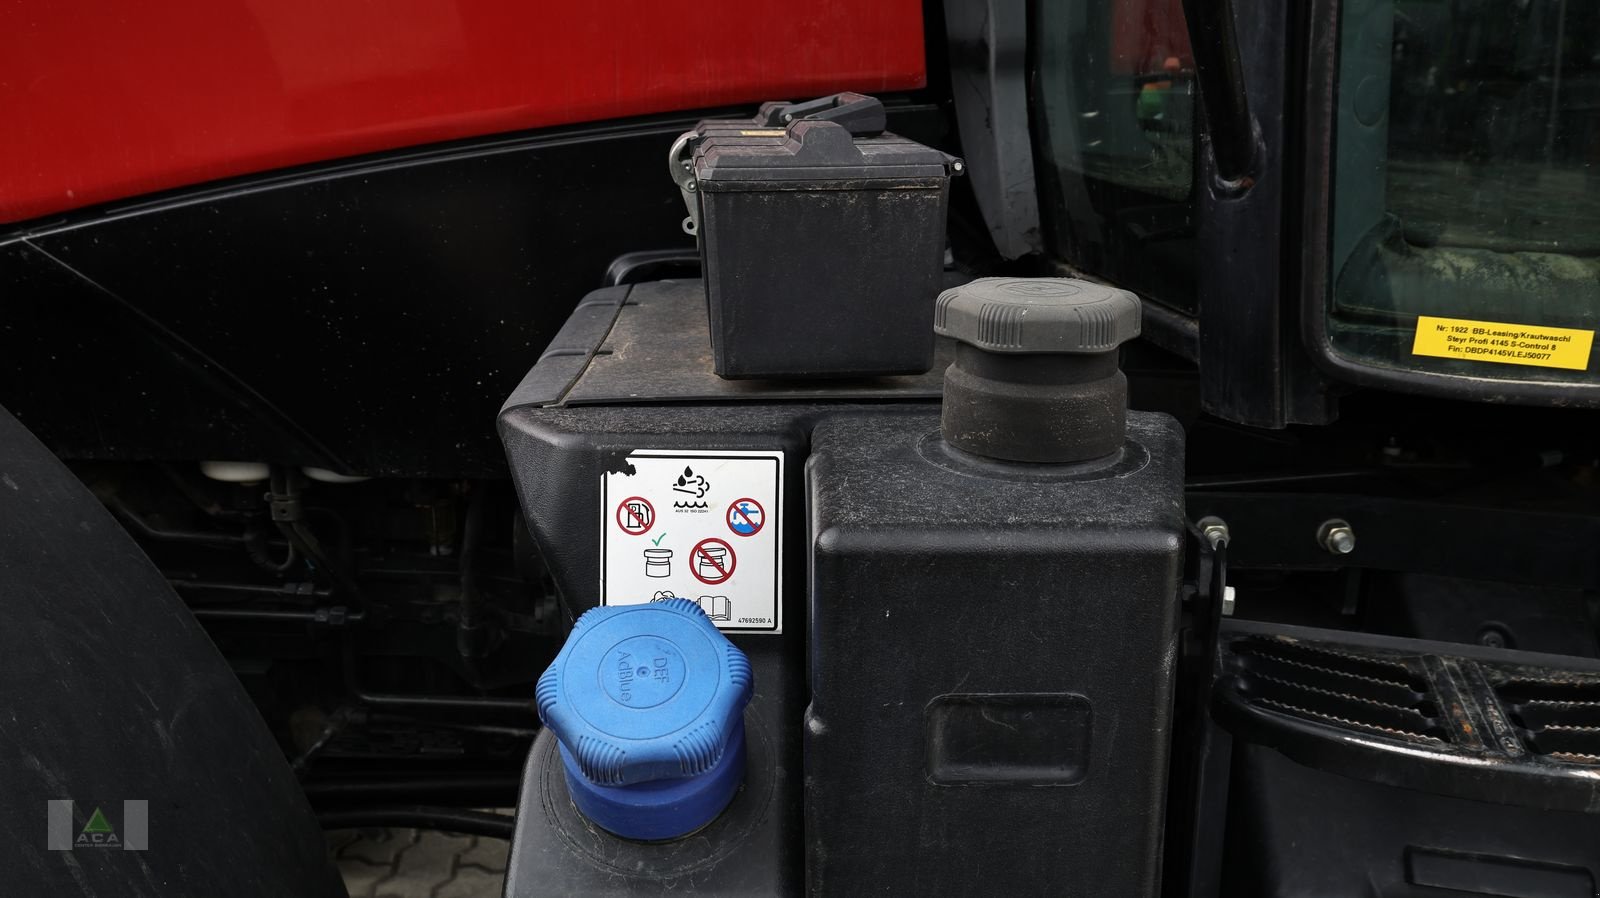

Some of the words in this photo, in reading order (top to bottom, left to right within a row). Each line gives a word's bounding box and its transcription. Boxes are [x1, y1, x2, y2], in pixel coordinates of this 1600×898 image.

[1436, 324, 1449, 332] Nr:
[1450, 325, 1468, 334] 1922
[1446, 335, 1467, 344] Steyr
[1469, 337, 1488, 345] Profi
[1489, 338, 1509, 347] 4145
[1510, 340, 1549, 351] S-Control
[1447, 345, 1463, 353] Fin:
[617, 650, 634, 702] AdBlue
[653, 657, 670, 683] DEF
